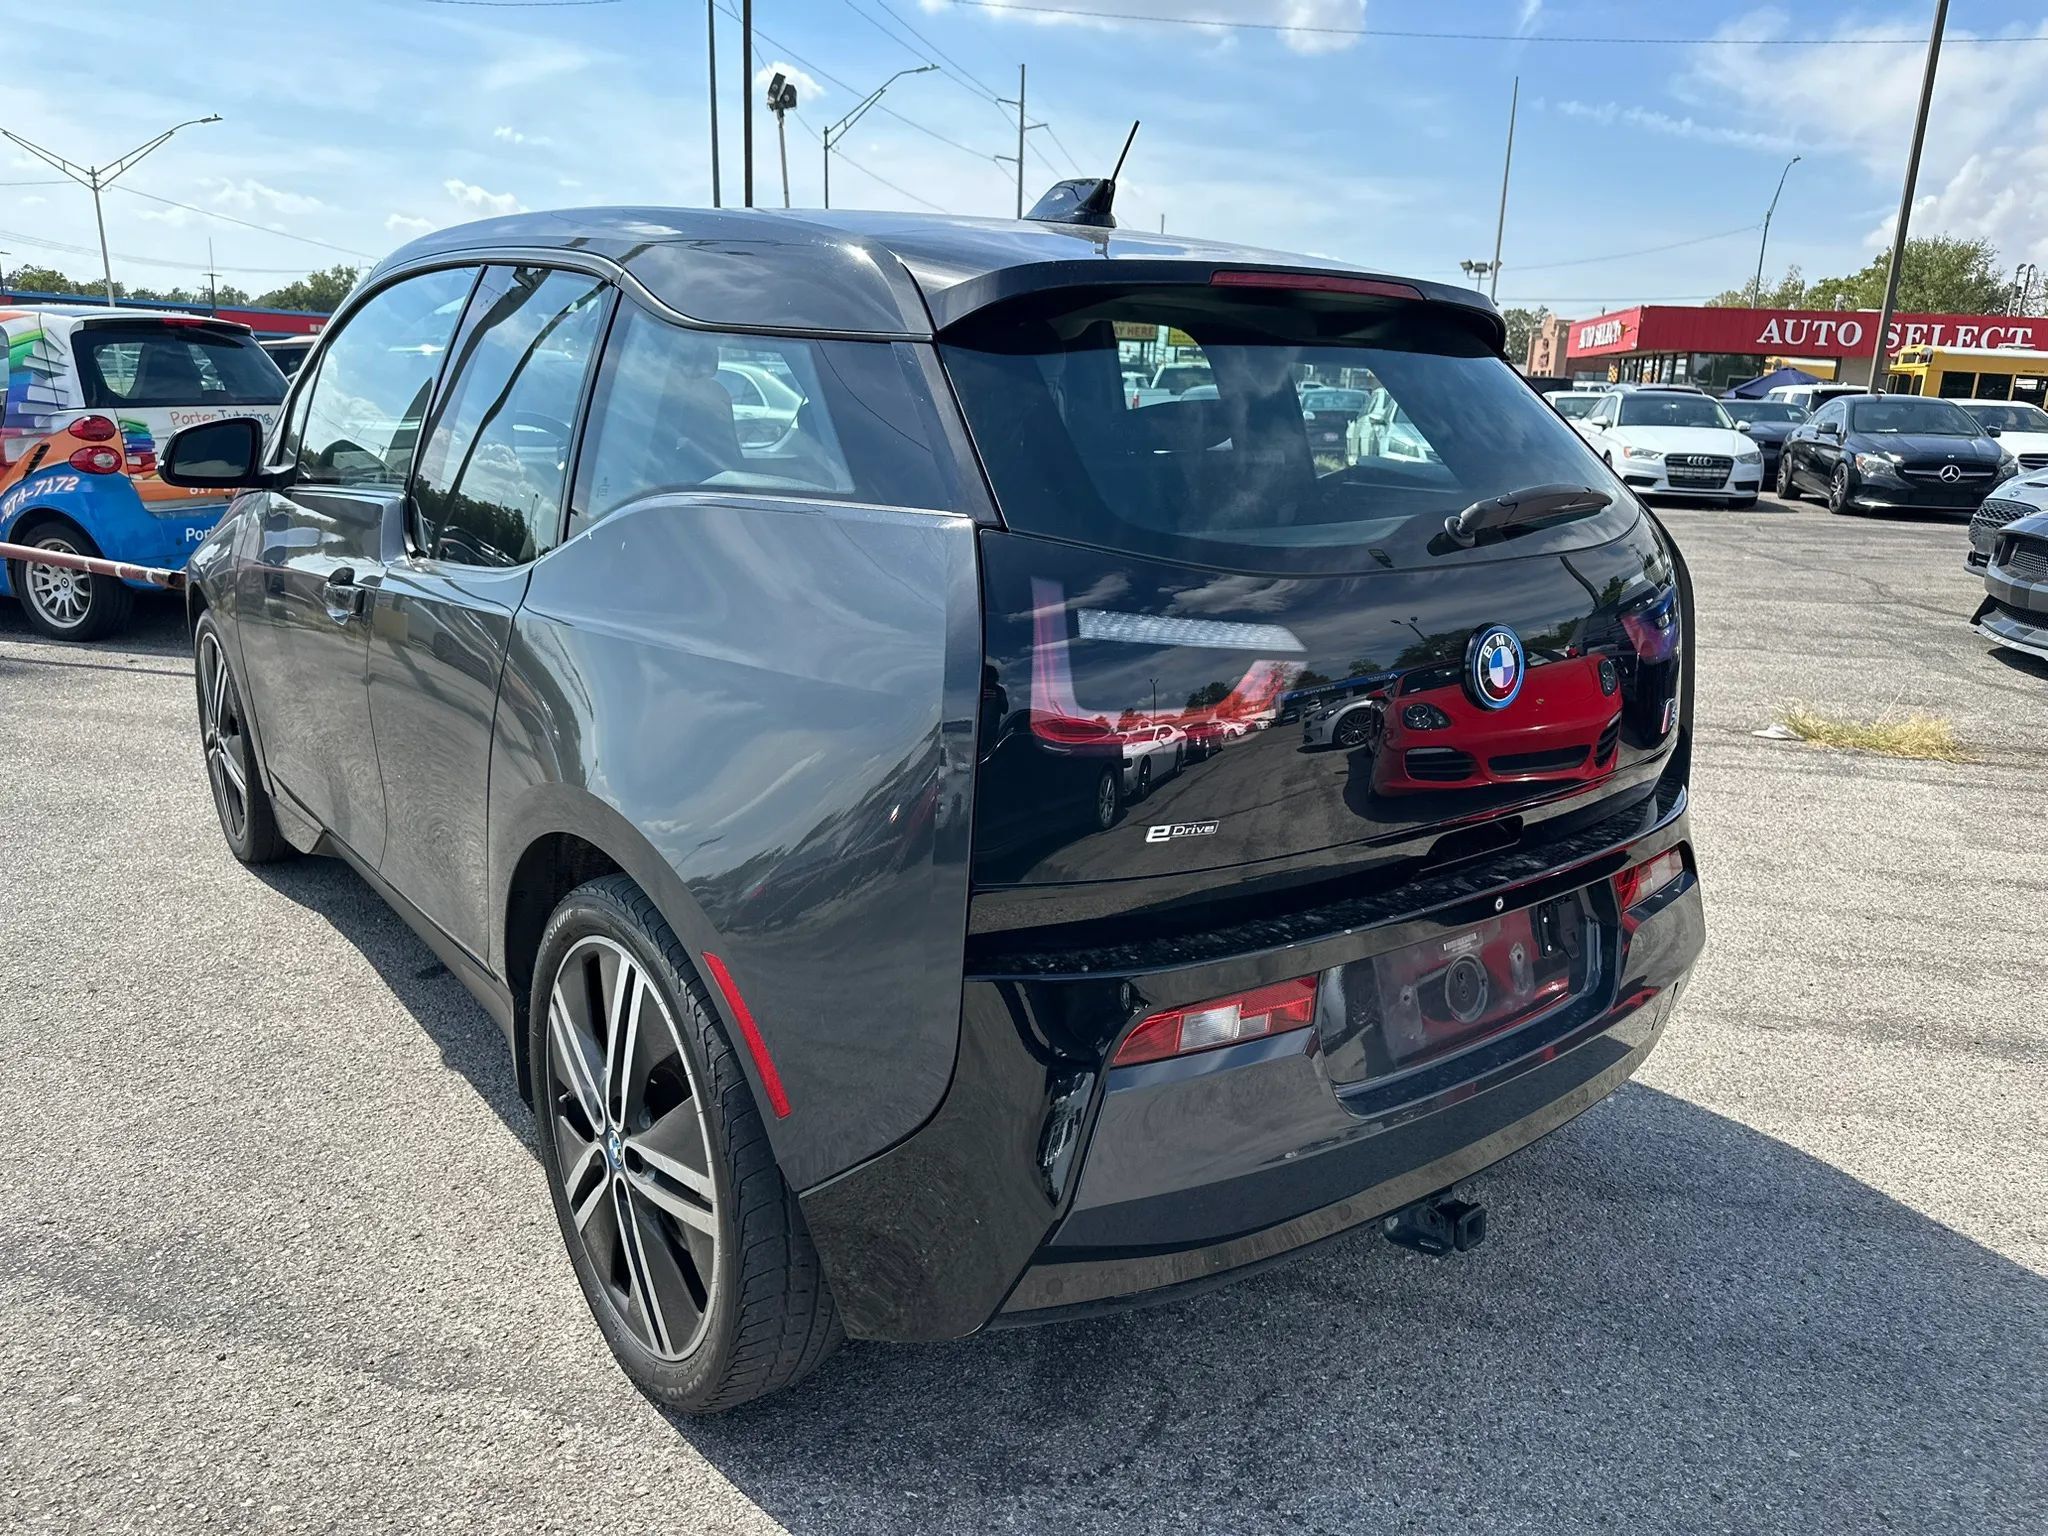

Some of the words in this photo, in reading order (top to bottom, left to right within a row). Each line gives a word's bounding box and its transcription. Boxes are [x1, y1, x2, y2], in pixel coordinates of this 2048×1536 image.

[1127, 325, 1155, 337] HERE
[1756, 318, 1863, 347] AUTO
[1885, 321, 2033, 349] SELECT
[170, 411, 217, 425] Porter
[1483, 634, 1517, 659] BMW
